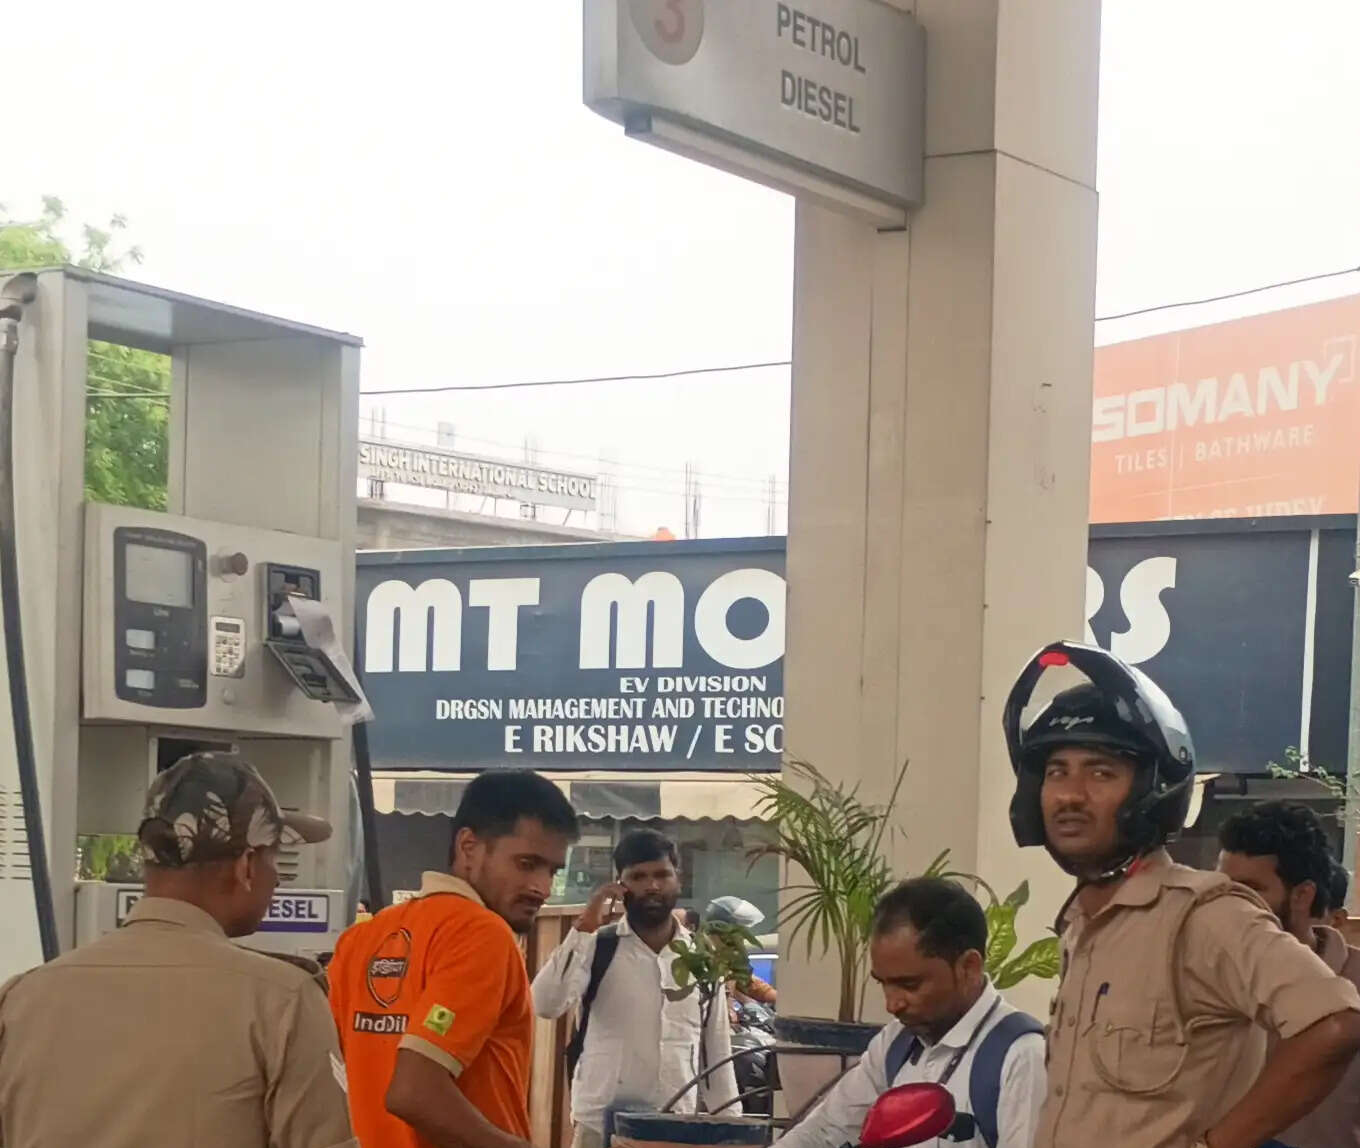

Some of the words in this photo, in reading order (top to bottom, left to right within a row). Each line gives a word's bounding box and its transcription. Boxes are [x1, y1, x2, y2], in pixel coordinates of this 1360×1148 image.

[776, 2, 866, 74] PETROL
[780, 69, 861, 134] DIESEL
[1092, 352, 1345, 442] SOMANY
[359, 446, 409, 470] SINGH
[411, 453, 534, 490] INTERNATIONAL
[539, 473, 596, 500] SCHOOL
[1114, 448, 1169, 474] TILES
[1194, 423, 1316, 463] BATHWARE
[365, 577, 541, 673] MT
[436, 699, 503, 720] DRGSN
[508, 698, 646, 719] MAHAGEMENT
[651, 697, 695, 719] AND
[620, 676, 650, 693] EV
[657, 676, 767, 692] DIVISION
[504, 725, 523, 753] E
[533, 724, 678, 753] RIKSHAW
[714, 724, 734, 753] E
[267, 900, 318, 919] ESEL
